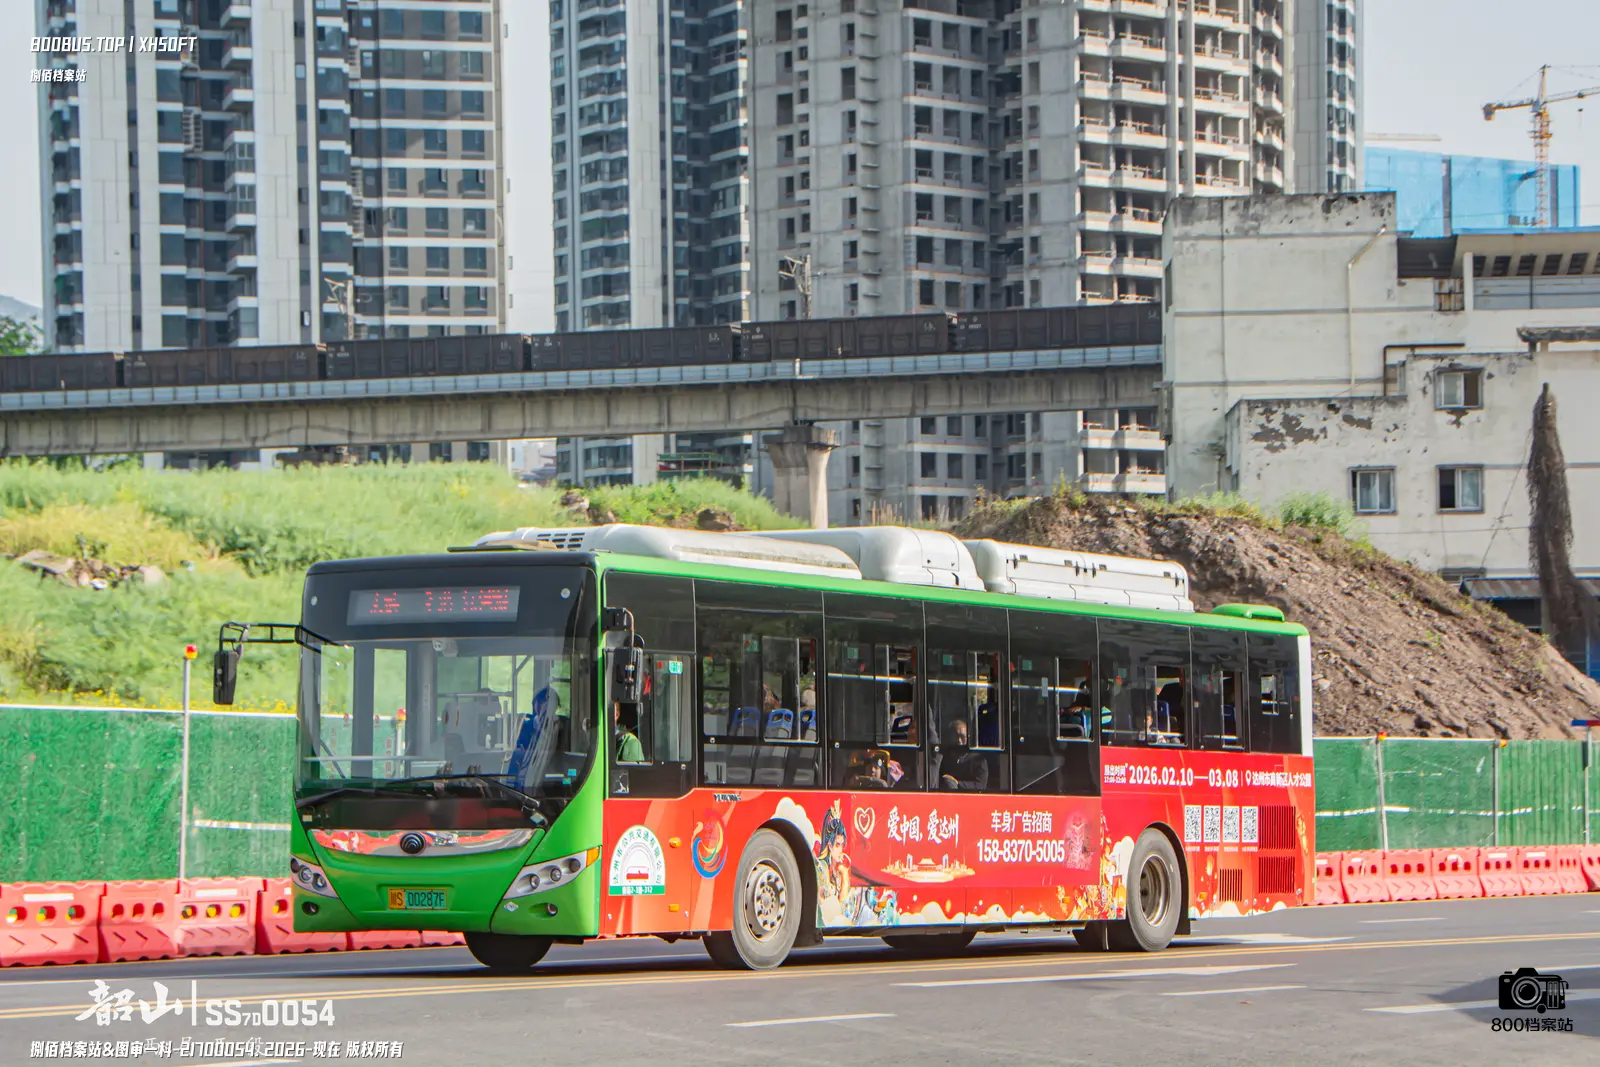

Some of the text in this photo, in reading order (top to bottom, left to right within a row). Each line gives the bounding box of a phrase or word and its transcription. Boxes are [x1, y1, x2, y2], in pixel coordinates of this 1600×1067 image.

[991, 809, 1053, 833] 车身广告招商
[977, 838, 1065, 863] 158-8370-5005
